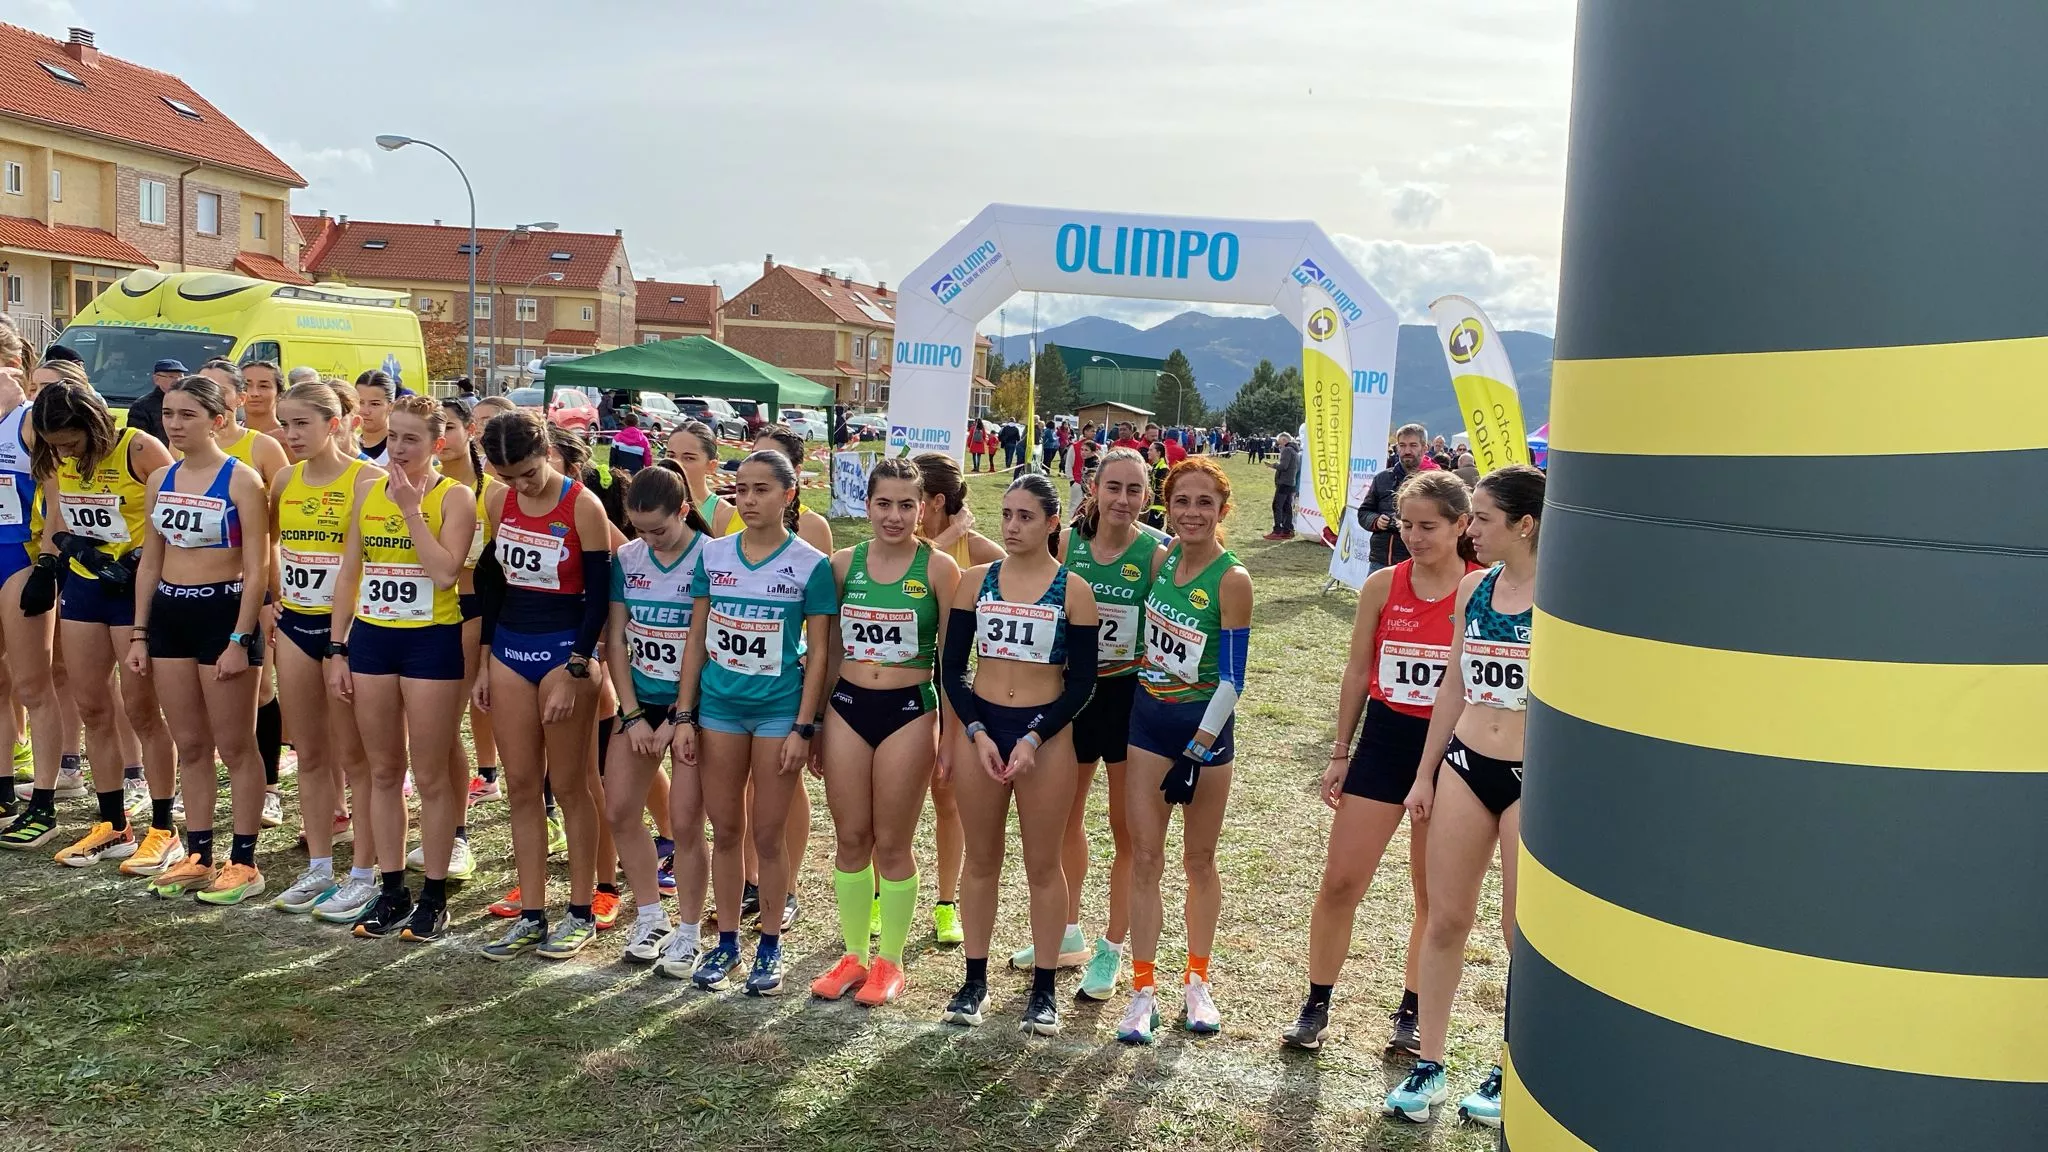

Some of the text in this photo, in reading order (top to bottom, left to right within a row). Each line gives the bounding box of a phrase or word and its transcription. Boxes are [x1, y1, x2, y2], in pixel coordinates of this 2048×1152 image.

[952, 240, 996, 280] OLIMPO
[1056, 223, 1239, 282] OLIMPO
[297, 315, 352, 331] AMBULANCIA
[897, 341, 962, 368] OLIMPO
[1353, 370, 1388, 395] MPO
[909, 427, 951, 443] OLIMPO
[69, 508, 111, 527] 106
[162, 508, 203, 532] 201
[281, 530, 343, 543] SCORPIO-71
[364, 536, 415, 549] SCORPIO-
[503, 544, 541, 572] 103
[286, 565, 327, 589] 307
[709, 571, 738, 586] ZENIT
[158, 581, 215, 598] KE PRO
[369, 580, 417, 603] 309
[1089, 582, 1134, 599] esca
[715, 602, 785, 619] ATLEET
[844, 608, 853, 616] COPA
[853, 609, 871, 619] ARAGÓN
[992, 605, 1011, 614] ARAGÓN
[1015, 608, 1029, 616] COPA
[1030, 610, 1053, 619] ESCOLAR
[741, 622, 754, 630] COPA
[756, 623, 778, 631] ESCOLAR
[852, 623, 902, 644] 204
[988, 618, 1034, 646] 311
[1098, 619, 1118, 641] 2
[633, 637, 677, 664] 303
[718, 629, 766, 658] 304
[1150, 624, 1187, 663] 104
[1425, 650, 1439, 658] COPA
[1495, 648, 1509, 656] COPA
[1510, 649, 1530, 658] ESCOLA
[1396, 661, 1447, 687] 107
[1471, 660, 1524, 689] 306
